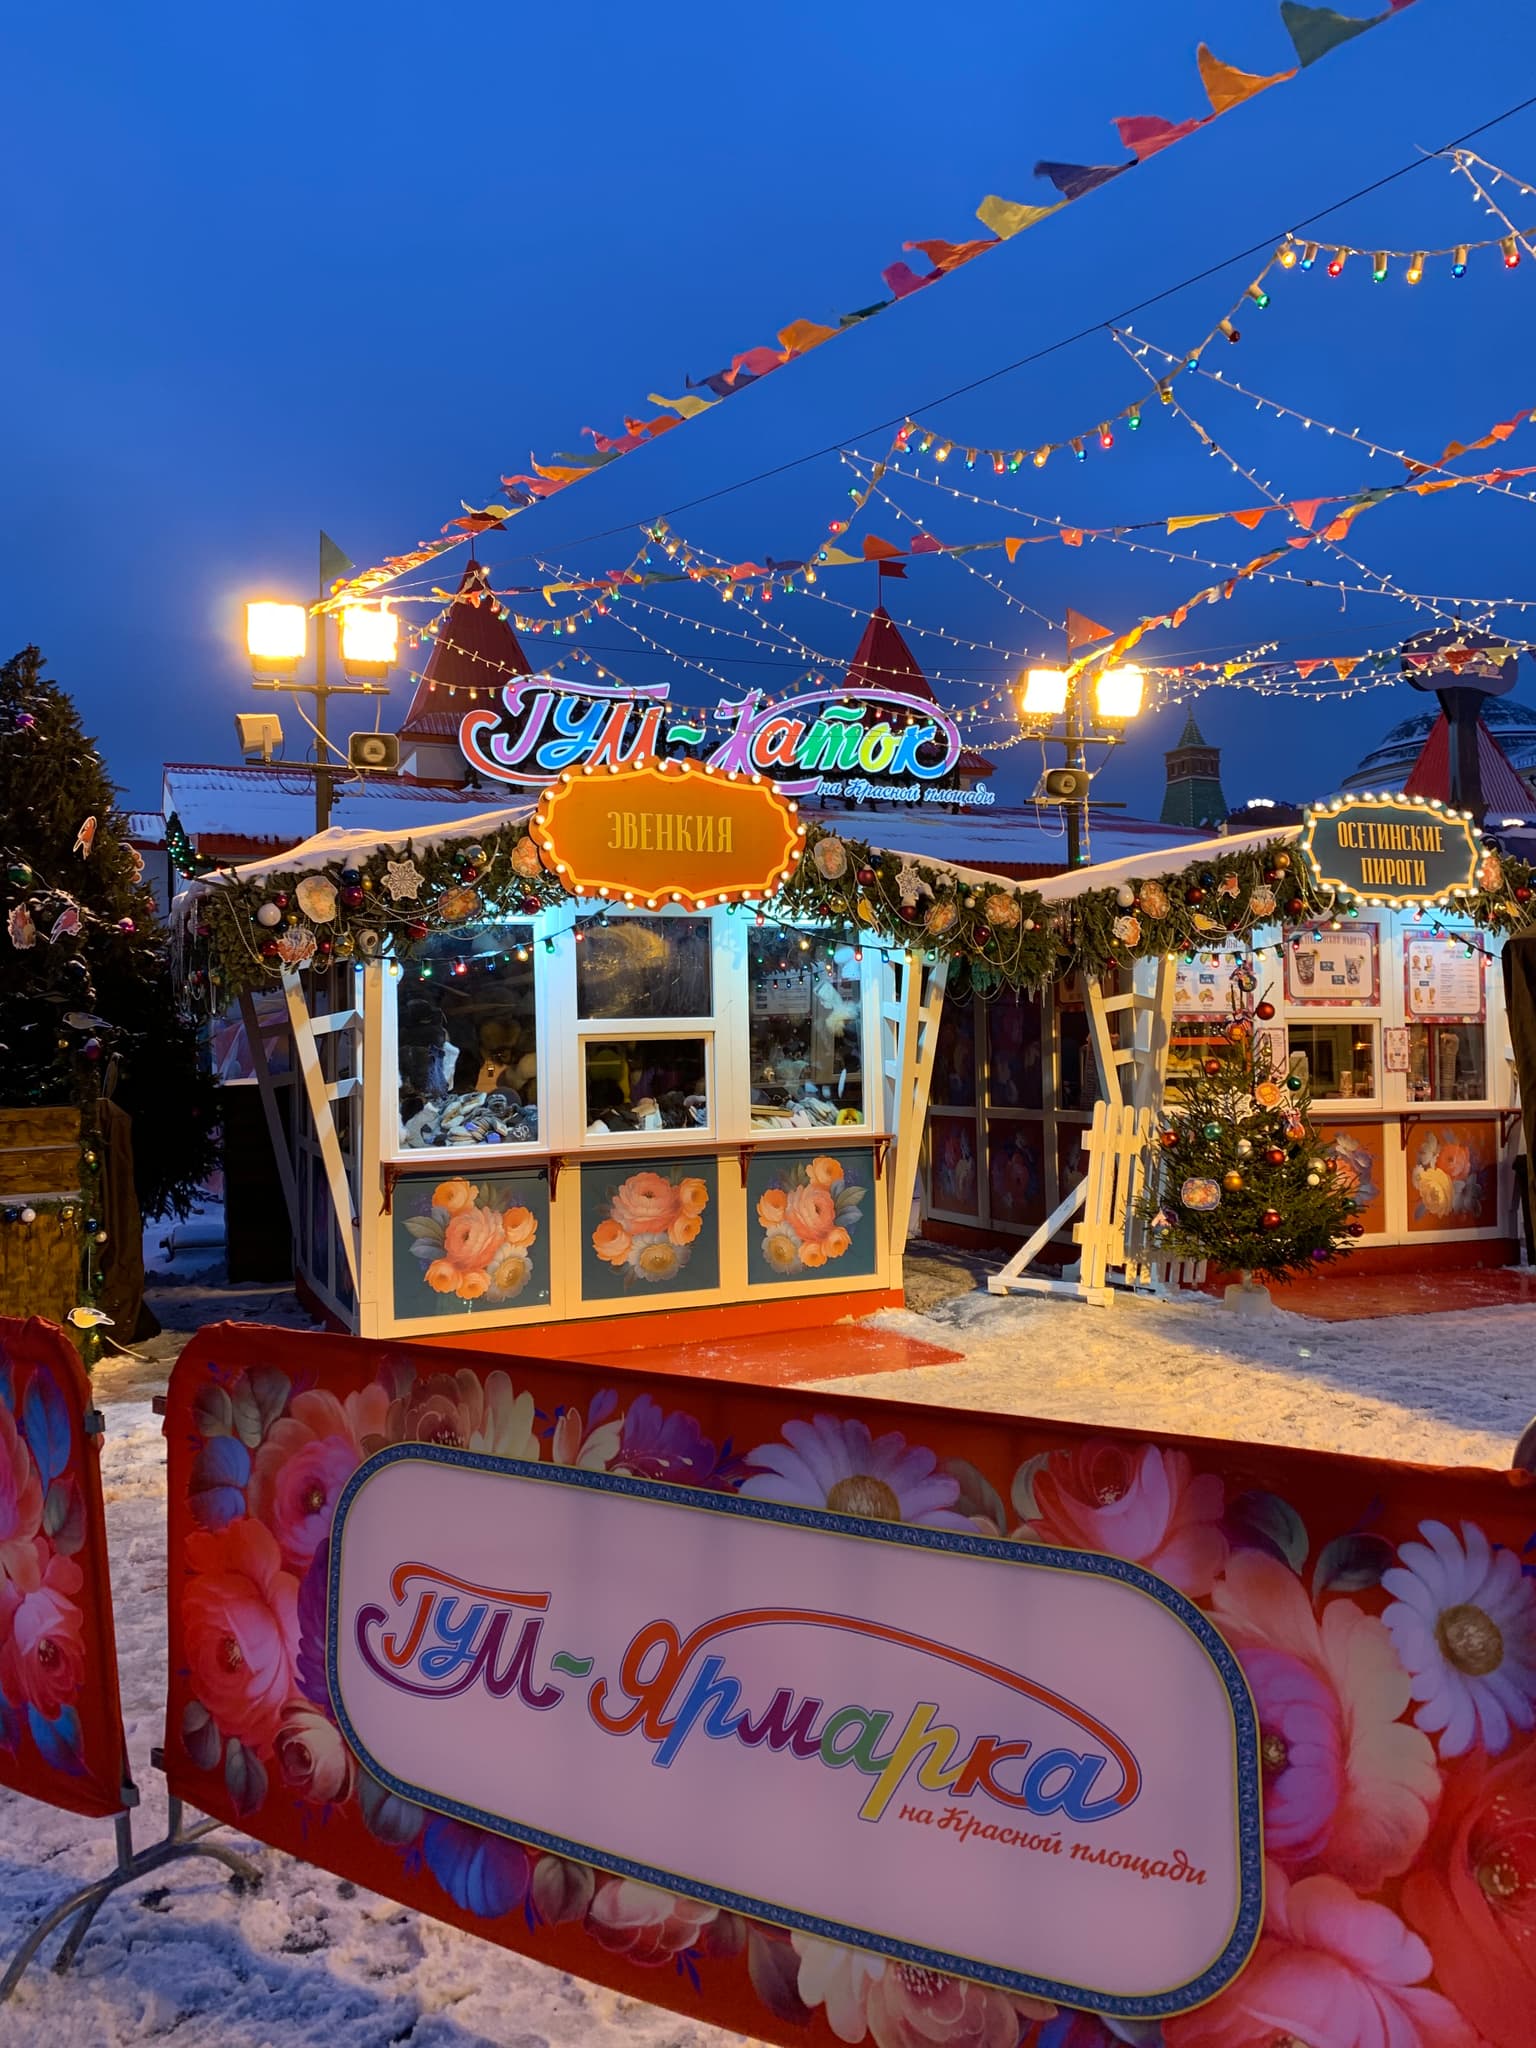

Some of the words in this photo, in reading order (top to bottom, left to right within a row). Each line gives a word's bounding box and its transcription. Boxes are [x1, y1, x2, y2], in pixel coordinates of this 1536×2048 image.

[817, 781, 842, 797] на
[844, 777, 921, 805] Красной
[923, 782, 996, 807] площади
[607, 811, 734, 853] ЭВЕНКИЯ
[1337, 821, 1446, 853] ОСЕТИНСКИЕ
[1360, 857, 1427, 887] ПИРОГИ
[898, 1803, 935, 1825] на
[937, 1806, 1063, 1856] Красной
[1069, 1842, 1208, 1886] площади
